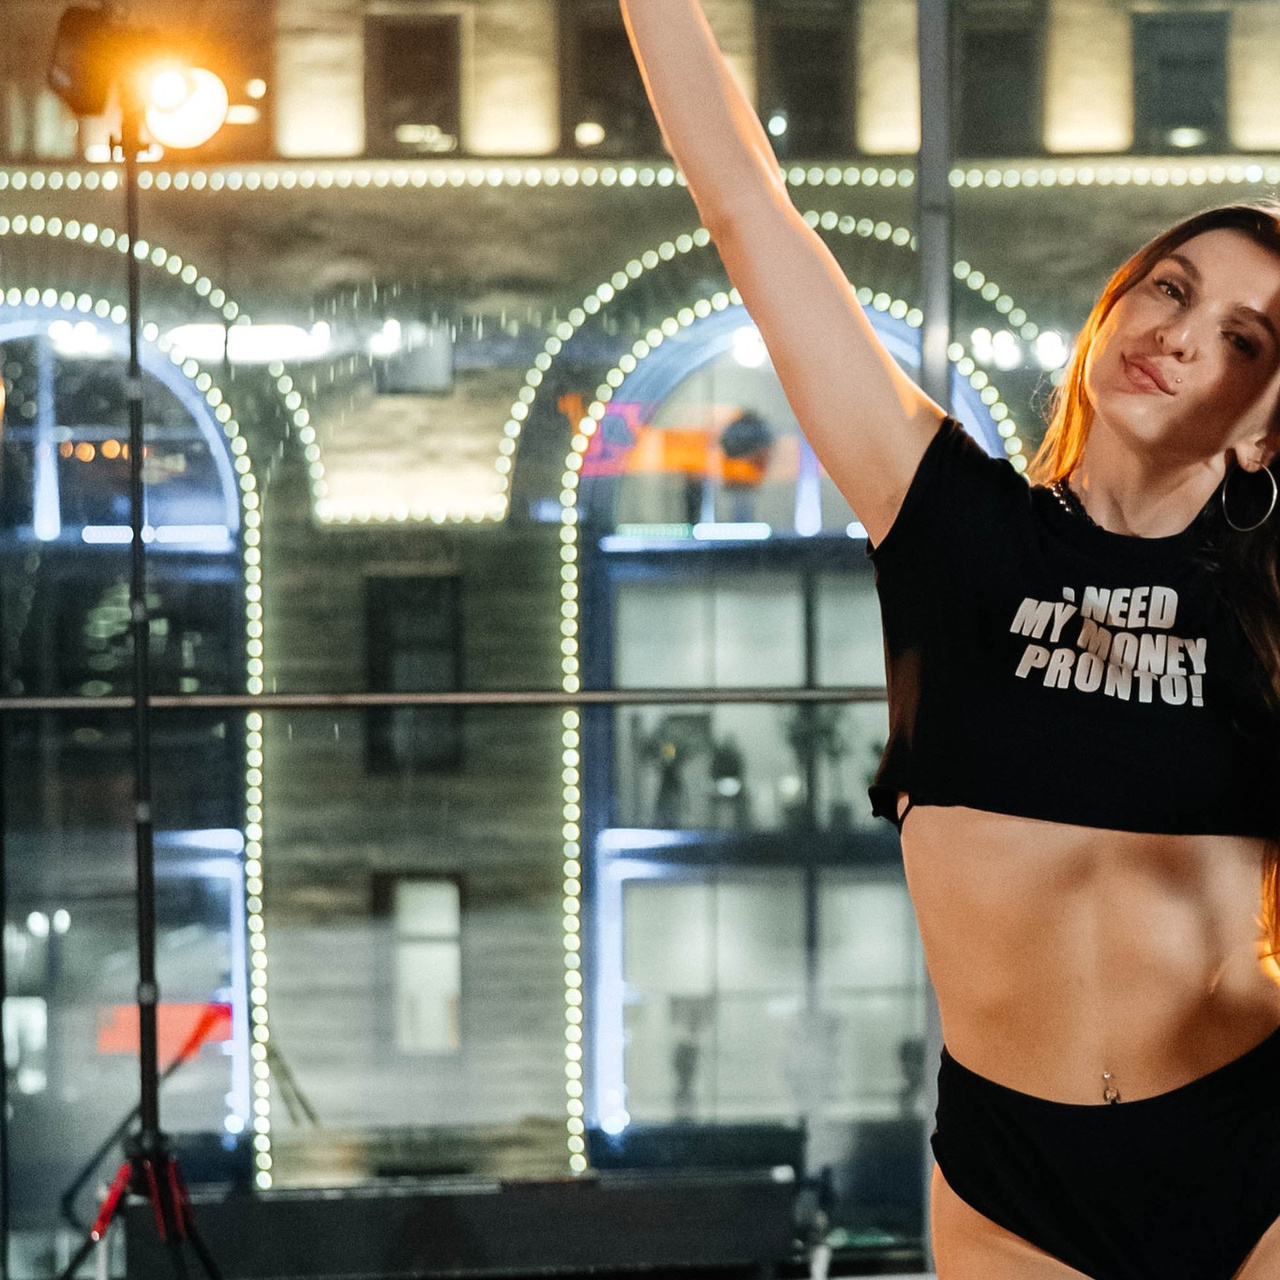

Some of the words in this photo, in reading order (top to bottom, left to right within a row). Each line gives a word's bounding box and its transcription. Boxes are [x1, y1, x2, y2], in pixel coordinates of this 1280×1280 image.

[1009, 597, 1077, 643] MY
[1077, 617, 1207, 675] MONEY
[1081, 585, 1179, 629] NEED
[1015, 643, 1204, 707] PRONTO!
